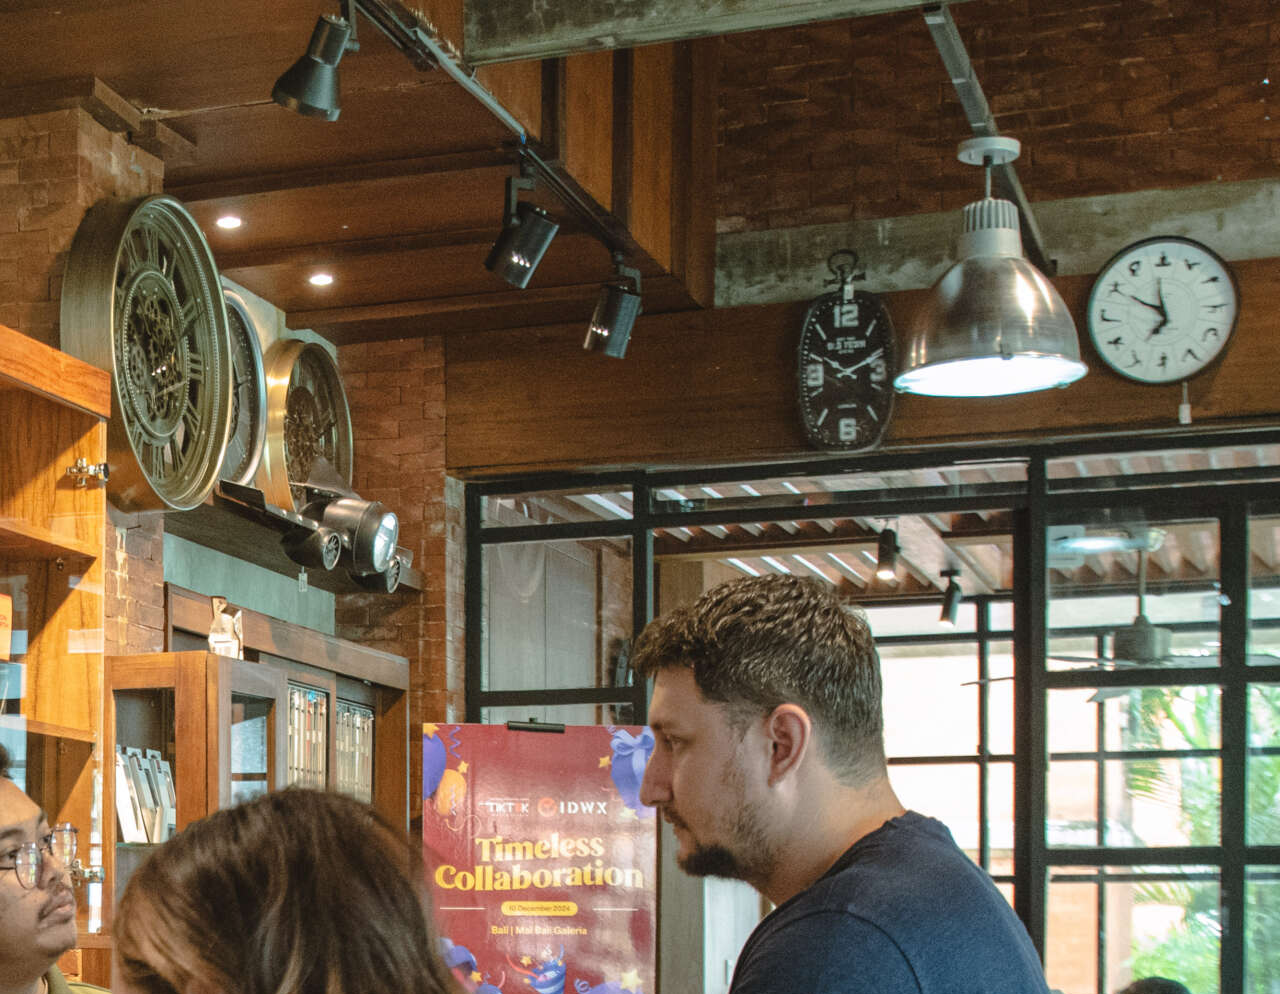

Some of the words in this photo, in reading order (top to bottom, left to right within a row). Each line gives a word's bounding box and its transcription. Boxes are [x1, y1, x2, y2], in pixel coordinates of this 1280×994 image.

[834, 304, 859, 328] 12
[559, 801, 608, 815] IDWX
[475, 832, 605, 862] Timeless
[434, 859, 644, 892] Collaboration
[491, 925, 509, 935] Bali
[553, 925, 588, 935] Galeria
